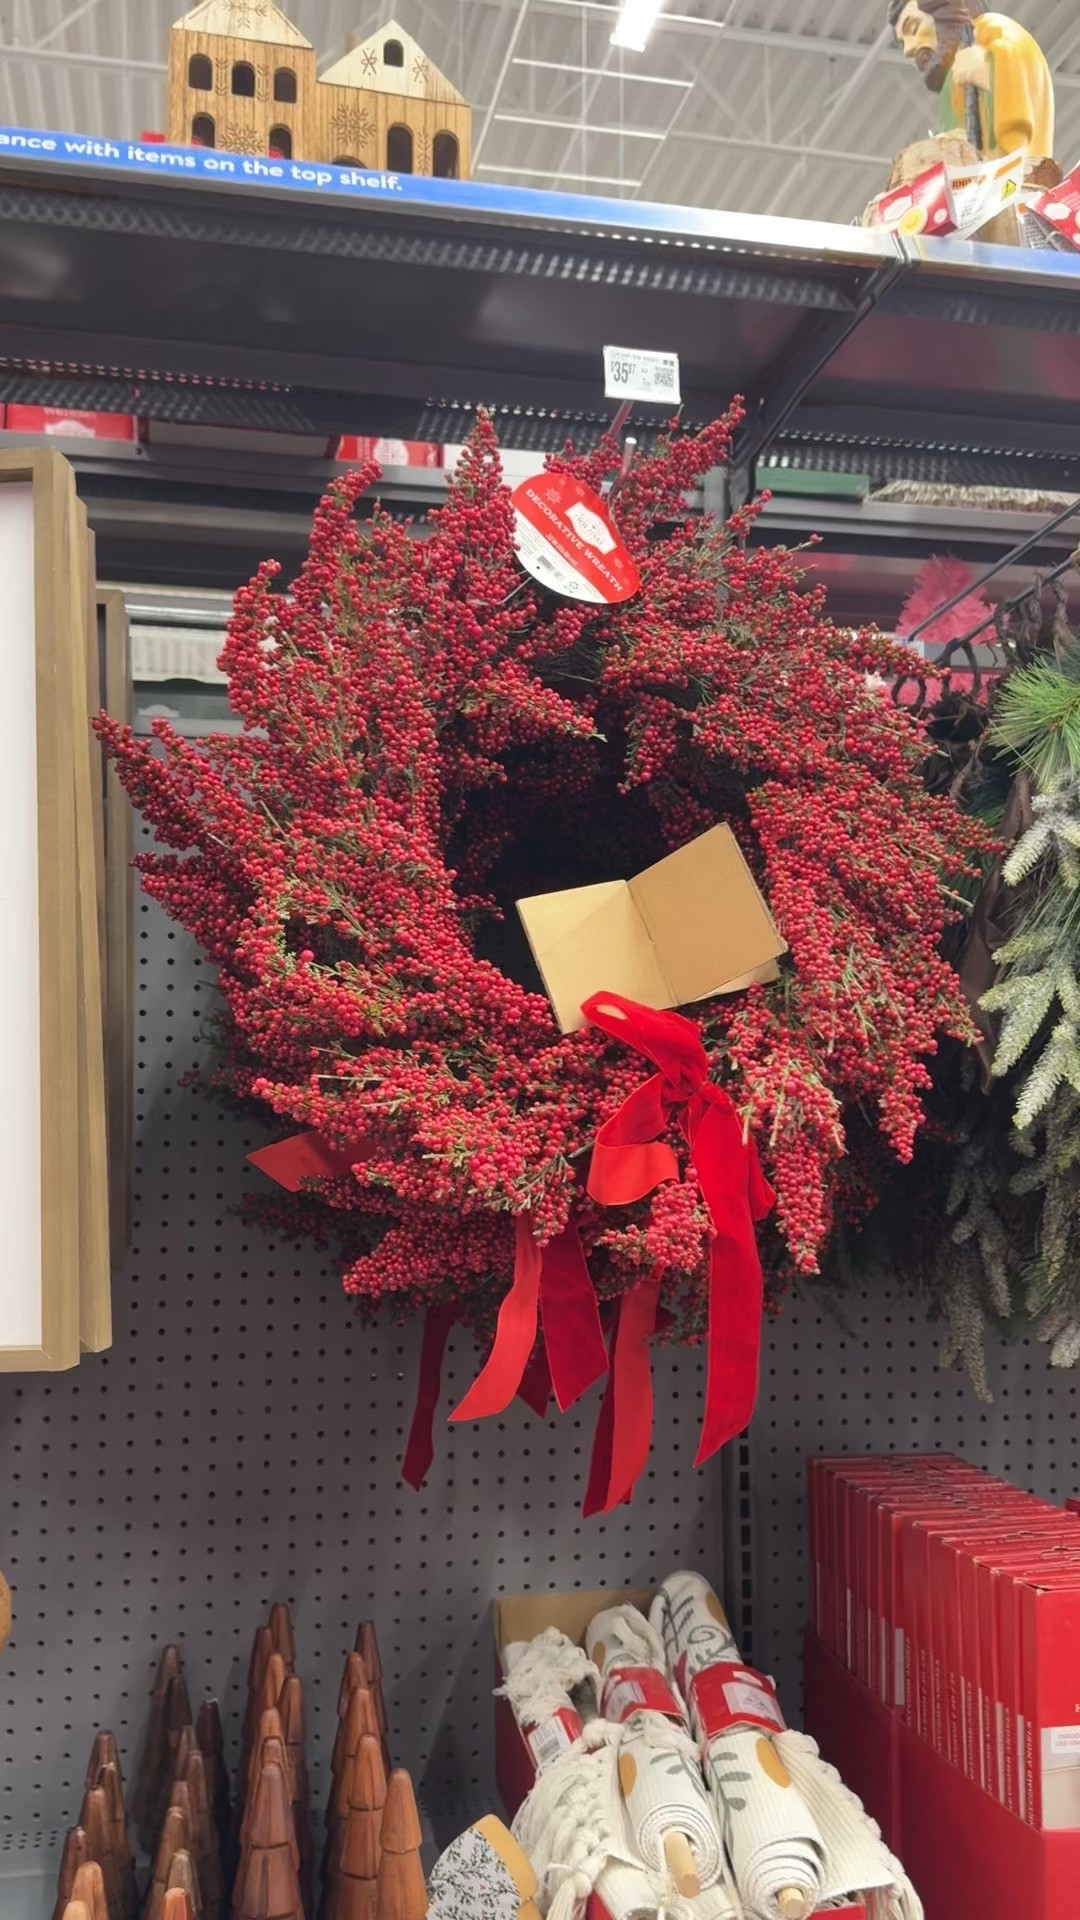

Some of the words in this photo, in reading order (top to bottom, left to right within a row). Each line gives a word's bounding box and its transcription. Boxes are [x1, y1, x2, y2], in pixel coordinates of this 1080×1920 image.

[65, 140, 120, 158] with
[128, 145, 196, 168] items
[203, 158, 235, 172] on
[242, 160, 284, 177] the
[291, 165, 333, 186] top
[340, 171, 403, 191] shelf.
[525, 488, 585, 550] DECORATIVE
[584, 548, 624, 592] WREATH
